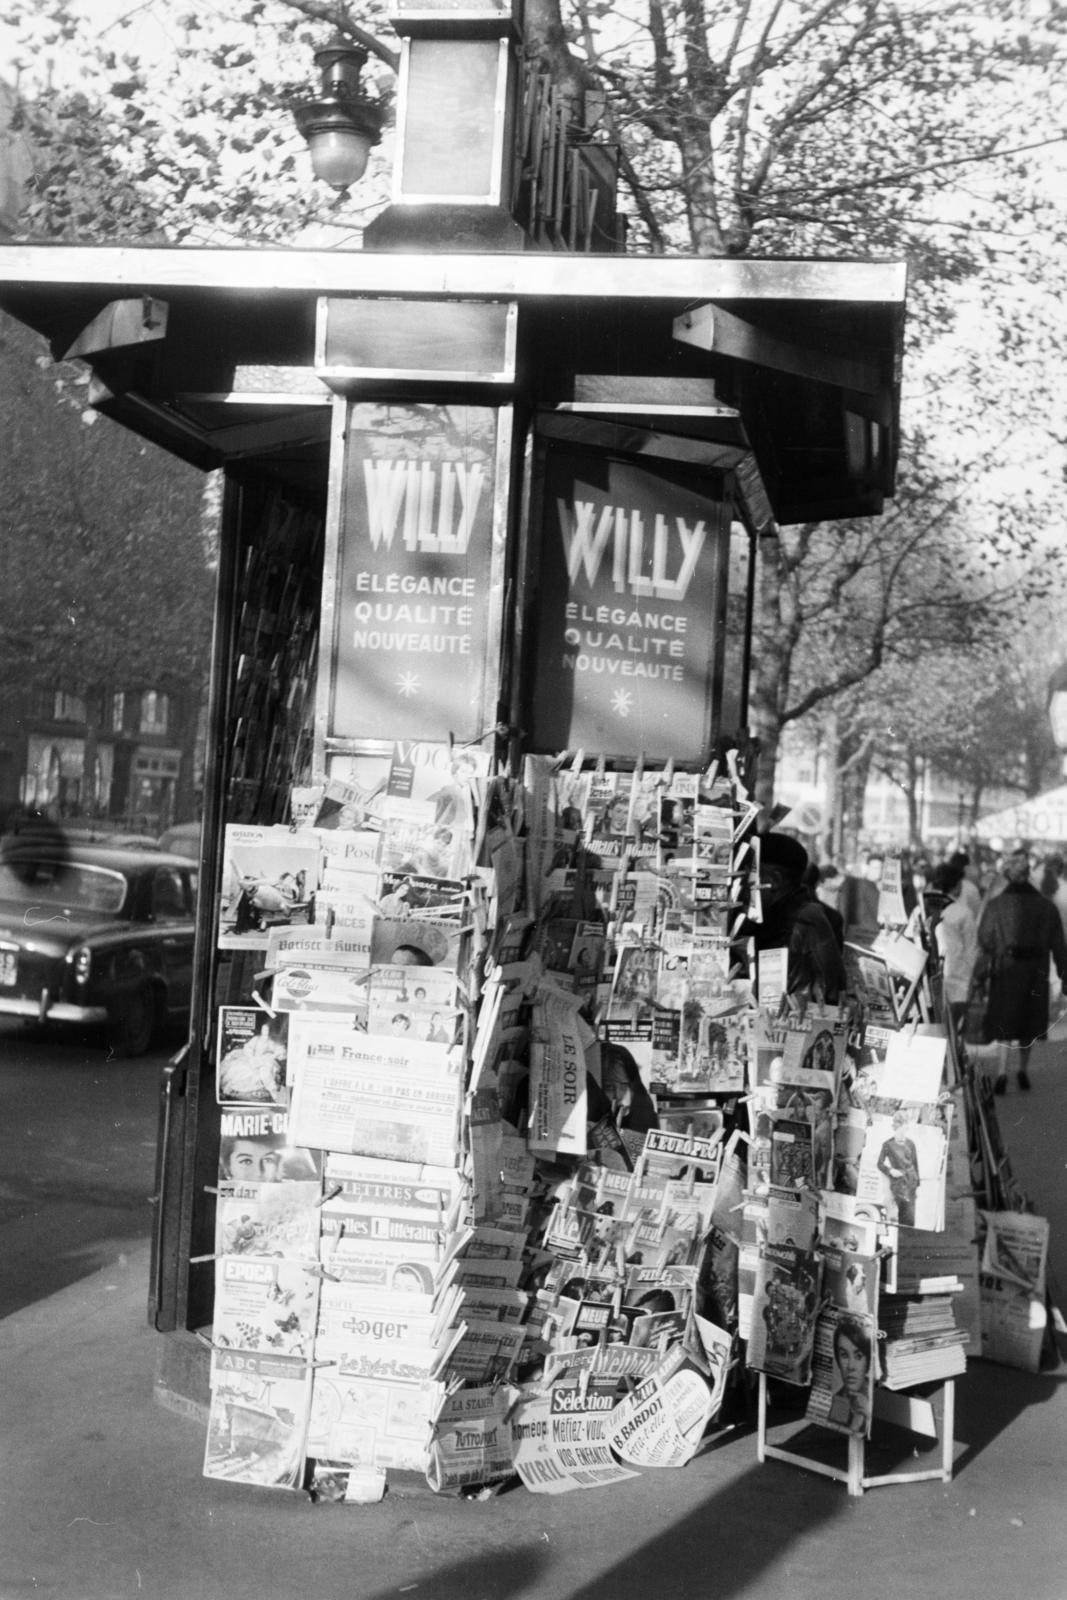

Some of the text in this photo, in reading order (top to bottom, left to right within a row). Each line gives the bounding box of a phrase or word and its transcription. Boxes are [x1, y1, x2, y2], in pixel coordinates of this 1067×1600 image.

[362, 459, 486, 554] WILLY
[557, 497, 706, 601] WILLY
[356, 571, 475, 597] ÉLÉGANCE
[354, 602, 473, 627] QUALITÉ
[565, 602, 687, 634] ÉLÉGANCE
[353, 630, 472, 655] NOUVEAUTÉ
[564, 628, 685, 658] QUALITÉ
[562, 652, 684, 682] NOUVEAUTÉ
[562, 1034, 577, 1105] LE SOIR
[343, 1182, 411, 1201] LETTRES
[580, 1308, 608, 1323] NEUE
[223, 1355, 257, 1371] ABC
[553, 1389, 613, 1411] Sélection
[620, 1396, 664, 1441] BARDOT
